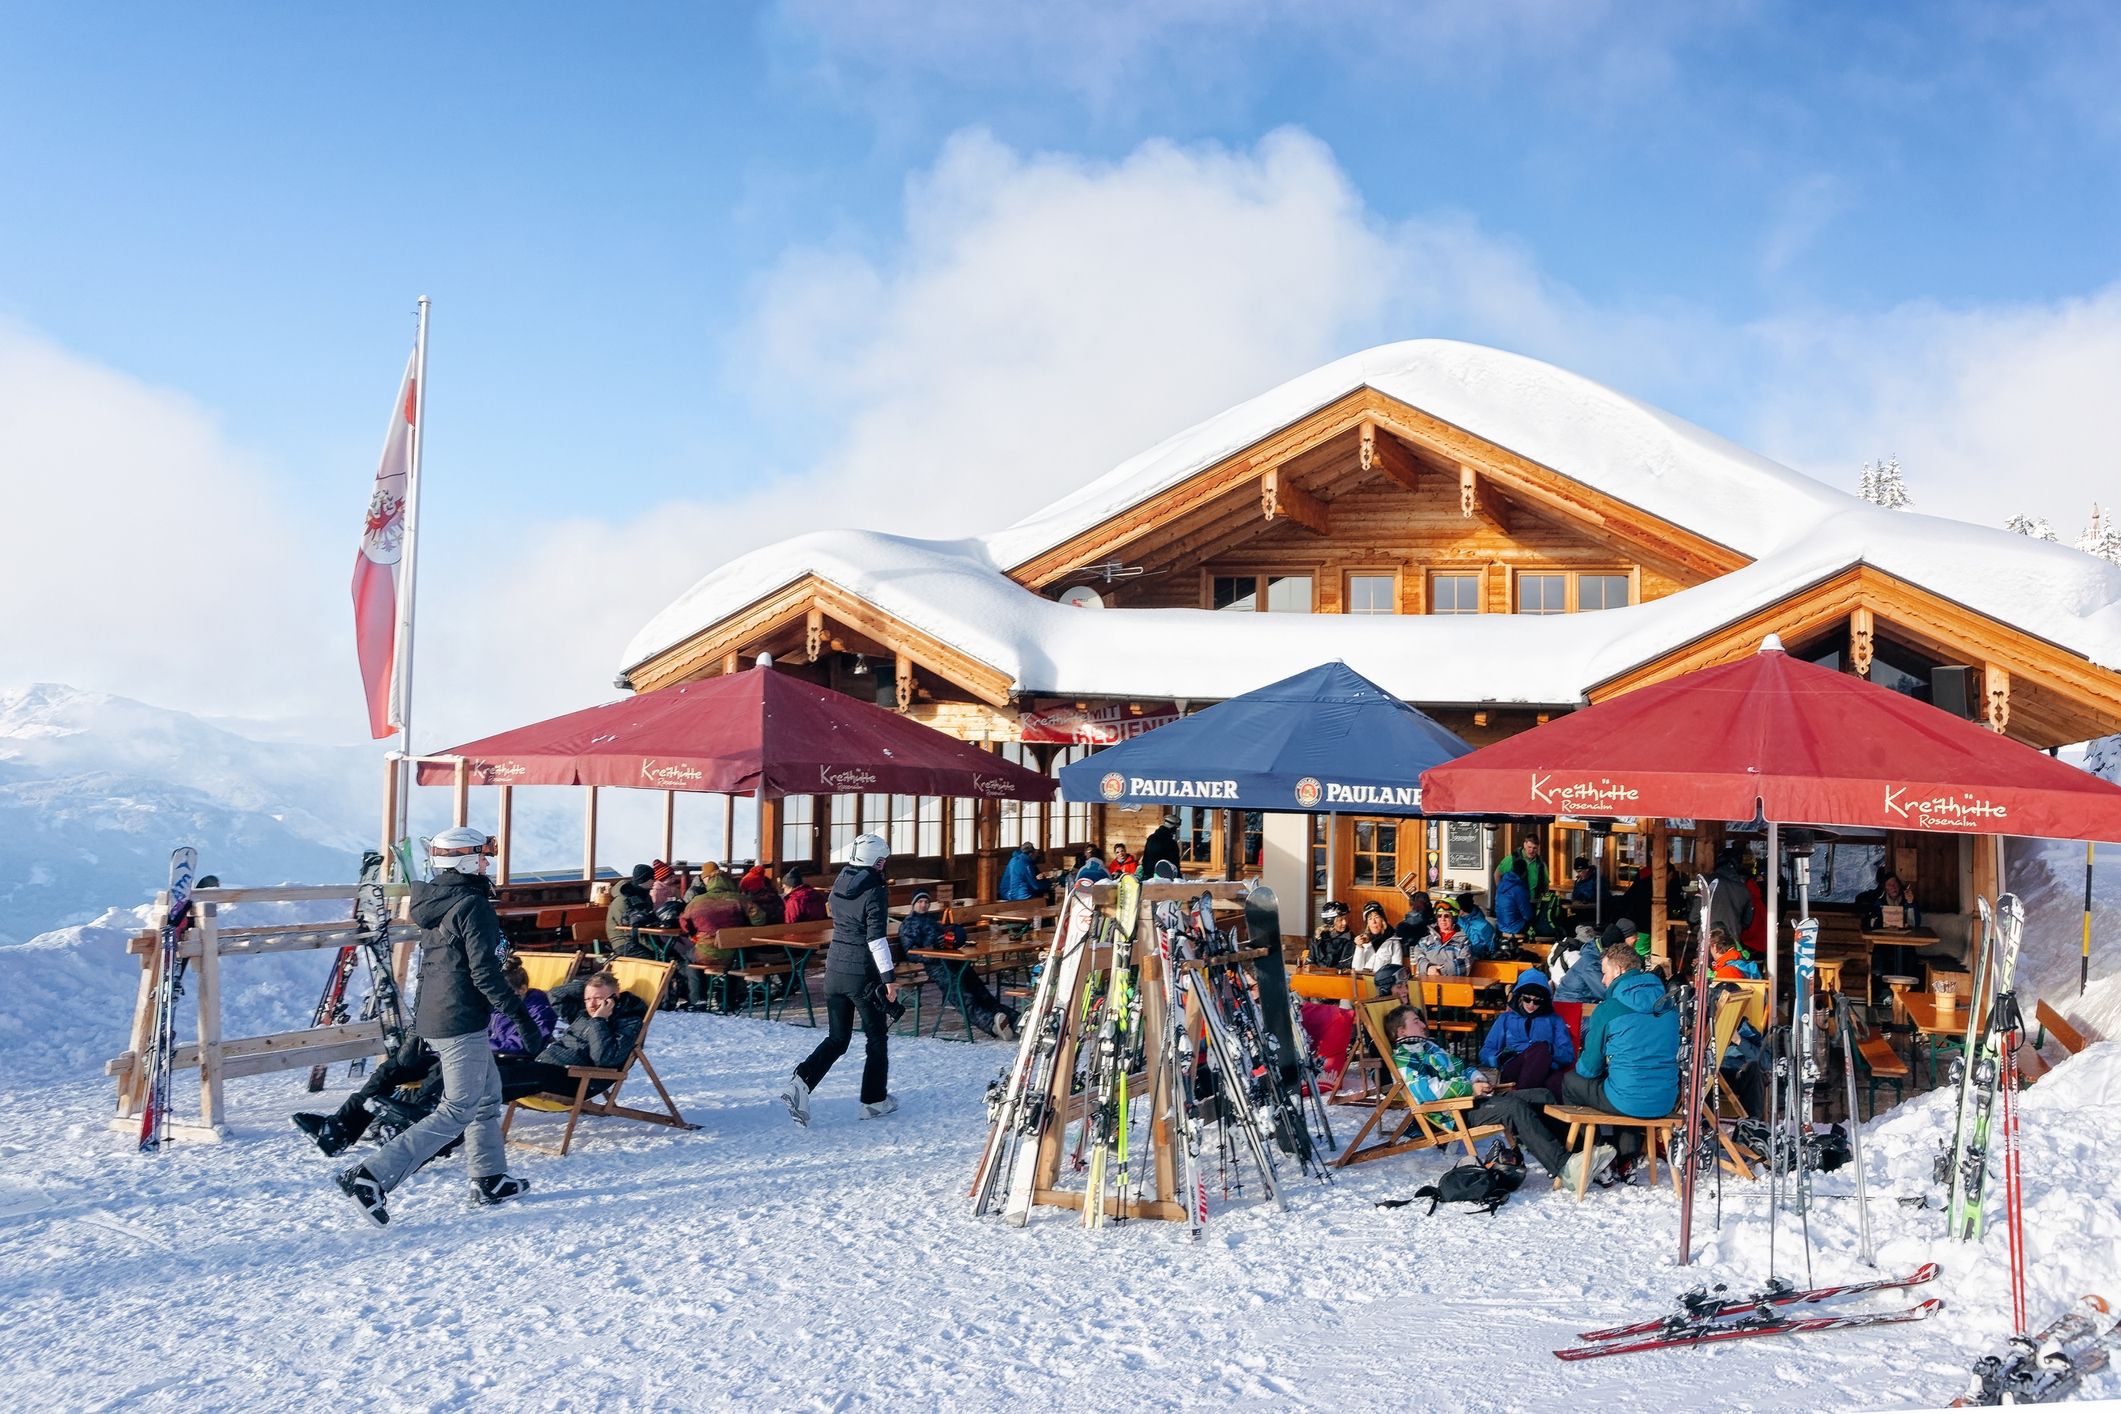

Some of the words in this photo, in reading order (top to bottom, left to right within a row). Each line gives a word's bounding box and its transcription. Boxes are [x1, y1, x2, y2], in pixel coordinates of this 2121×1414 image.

[1090, 705, 1119, 720] MIT
[1130, 777, 1240, 799] PAULANER
[1326, 783, 1424, 806] PAULANE
[1531, 773, 1640, 804] Kreithütte
[1561, 800, 1613, 813] Rosenalm
[1884, 784, 2008, 819] Kreithütte
[1918, 814, 1977, 829] Rosenalm
